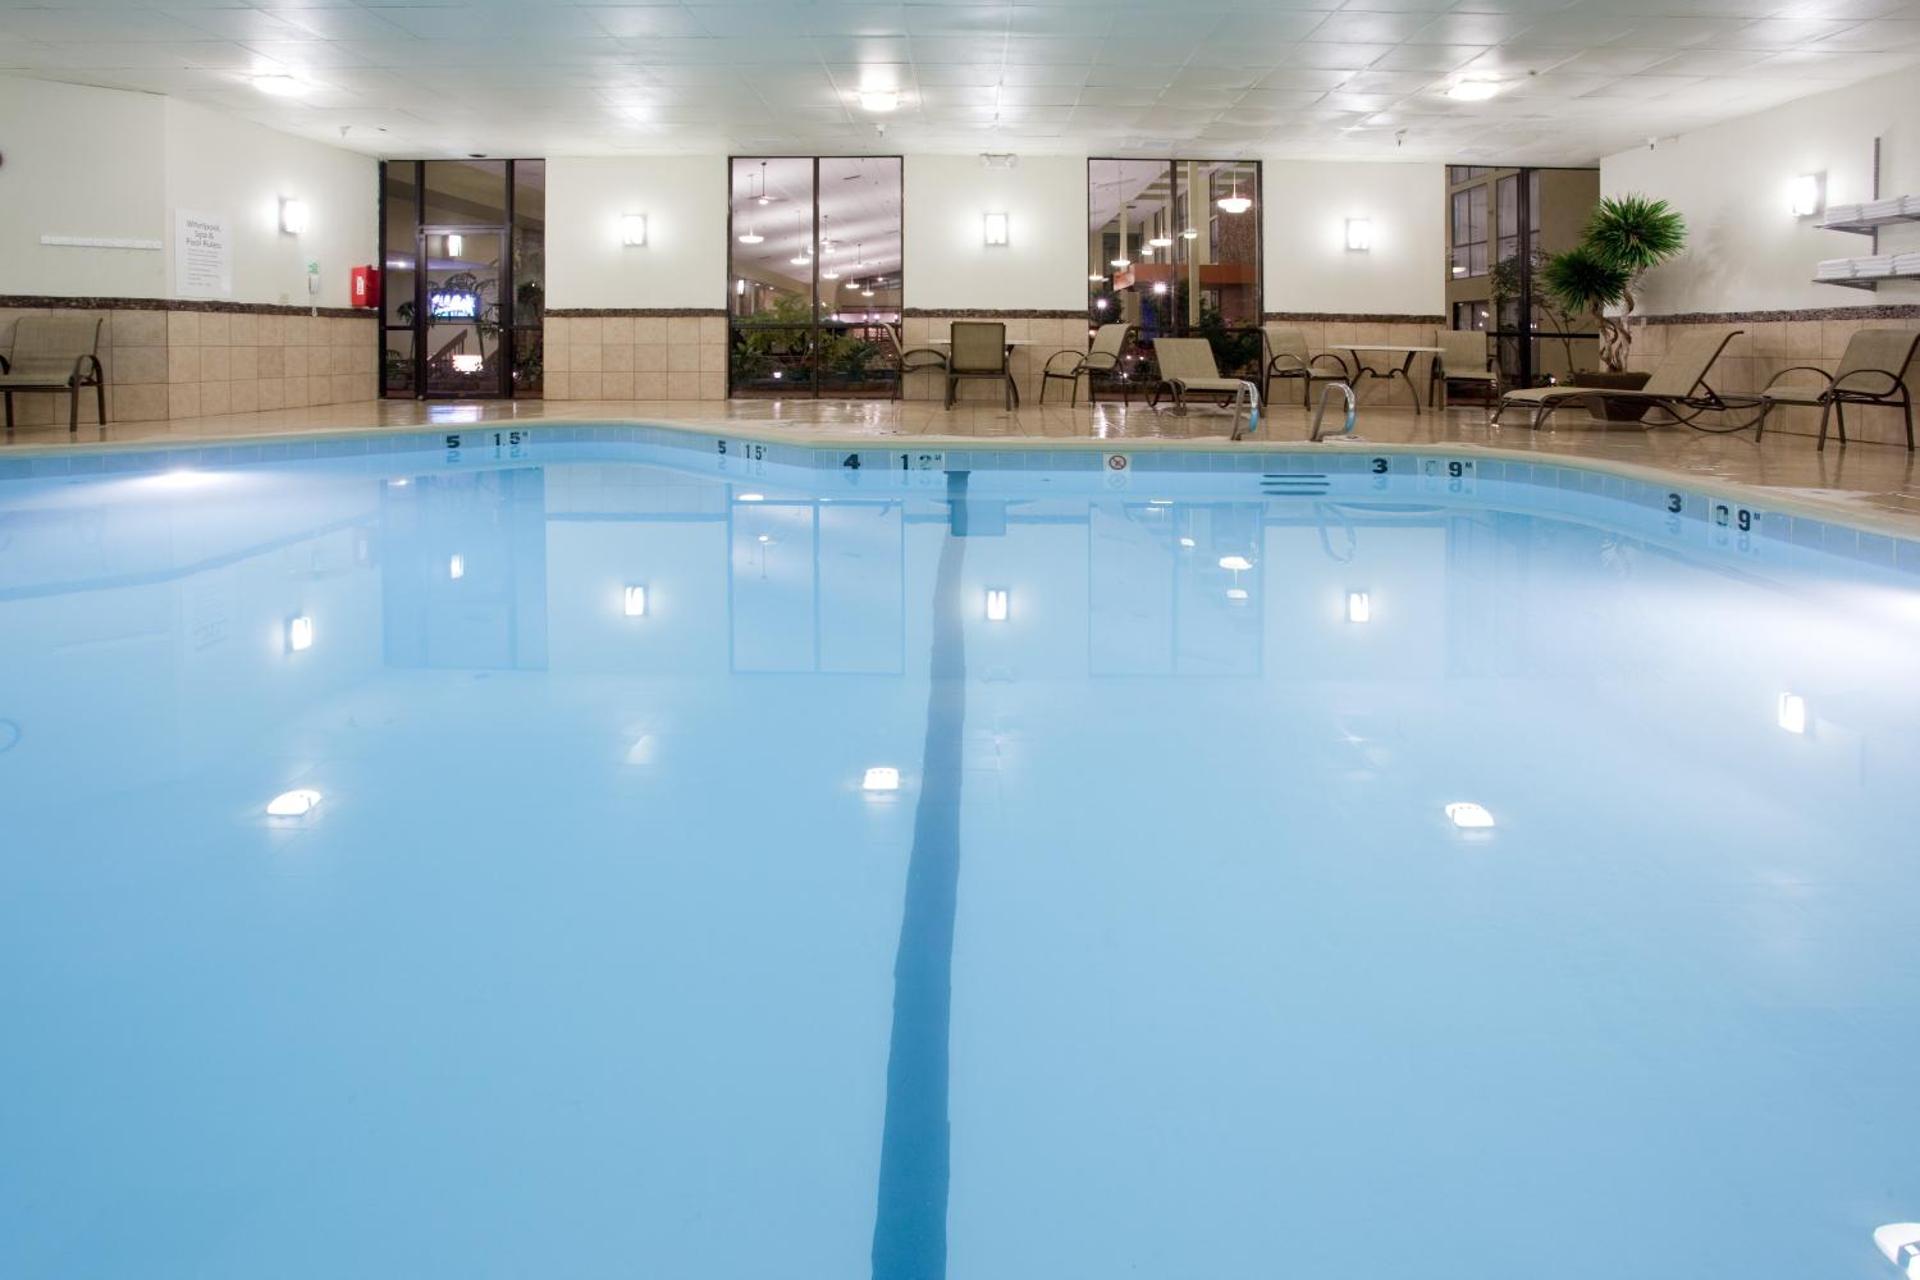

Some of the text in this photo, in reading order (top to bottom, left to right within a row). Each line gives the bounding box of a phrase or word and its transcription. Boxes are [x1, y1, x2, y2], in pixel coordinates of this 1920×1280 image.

[185, 236, 202, 247] Pool
[446, 434, 461, 449] 5
[717, 439, 727, 455] 5
[843, 453, 861, 470] 4
[1372, 458, 1388, 474] 3
[1668, 493, 1682, 514] 3
